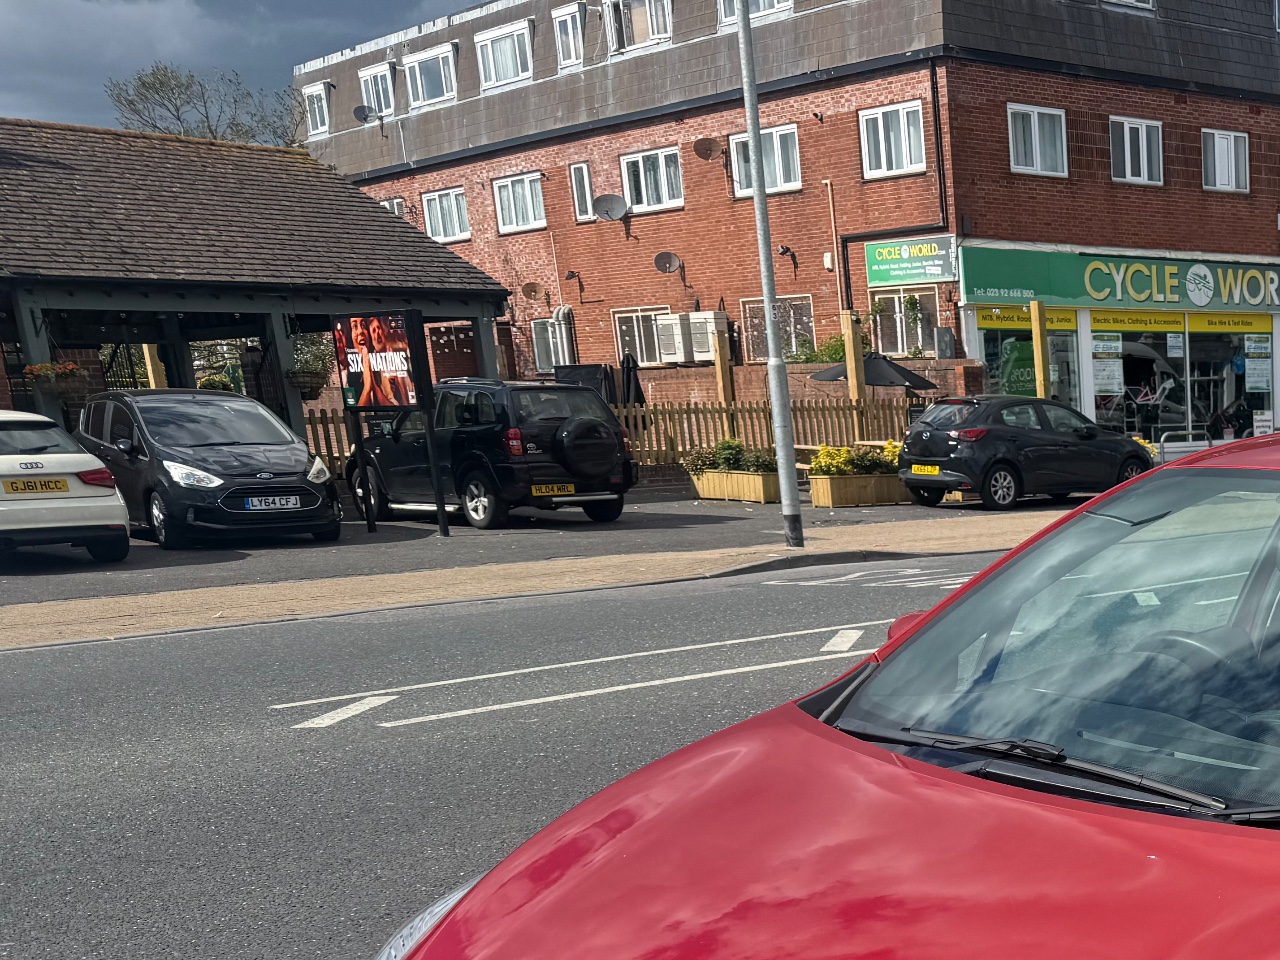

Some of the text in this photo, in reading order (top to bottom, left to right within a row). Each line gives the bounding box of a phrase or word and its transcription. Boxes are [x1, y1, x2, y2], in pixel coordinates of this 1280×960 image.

[876, 243, 939, 260] CYCLE WORLD
[1084, 261, 1180, 302] CYCLE
[987, 288, 999, 297] 023
[1000, 289, 1009, 297] 92
[1010, 289, 1021, 297] 666
[1022, 290, 1035, 298] 500
[1127, 318, 1148, 326] Clothing
[347, 353, 364, 373] SIX
[369, 351, 408, 372] NATIONS
[10, 481, 63, 492] GJ61 HCC
[535, 485, 555, 494] HL04
[250, 496, 299, 509] LY64 CFJ
